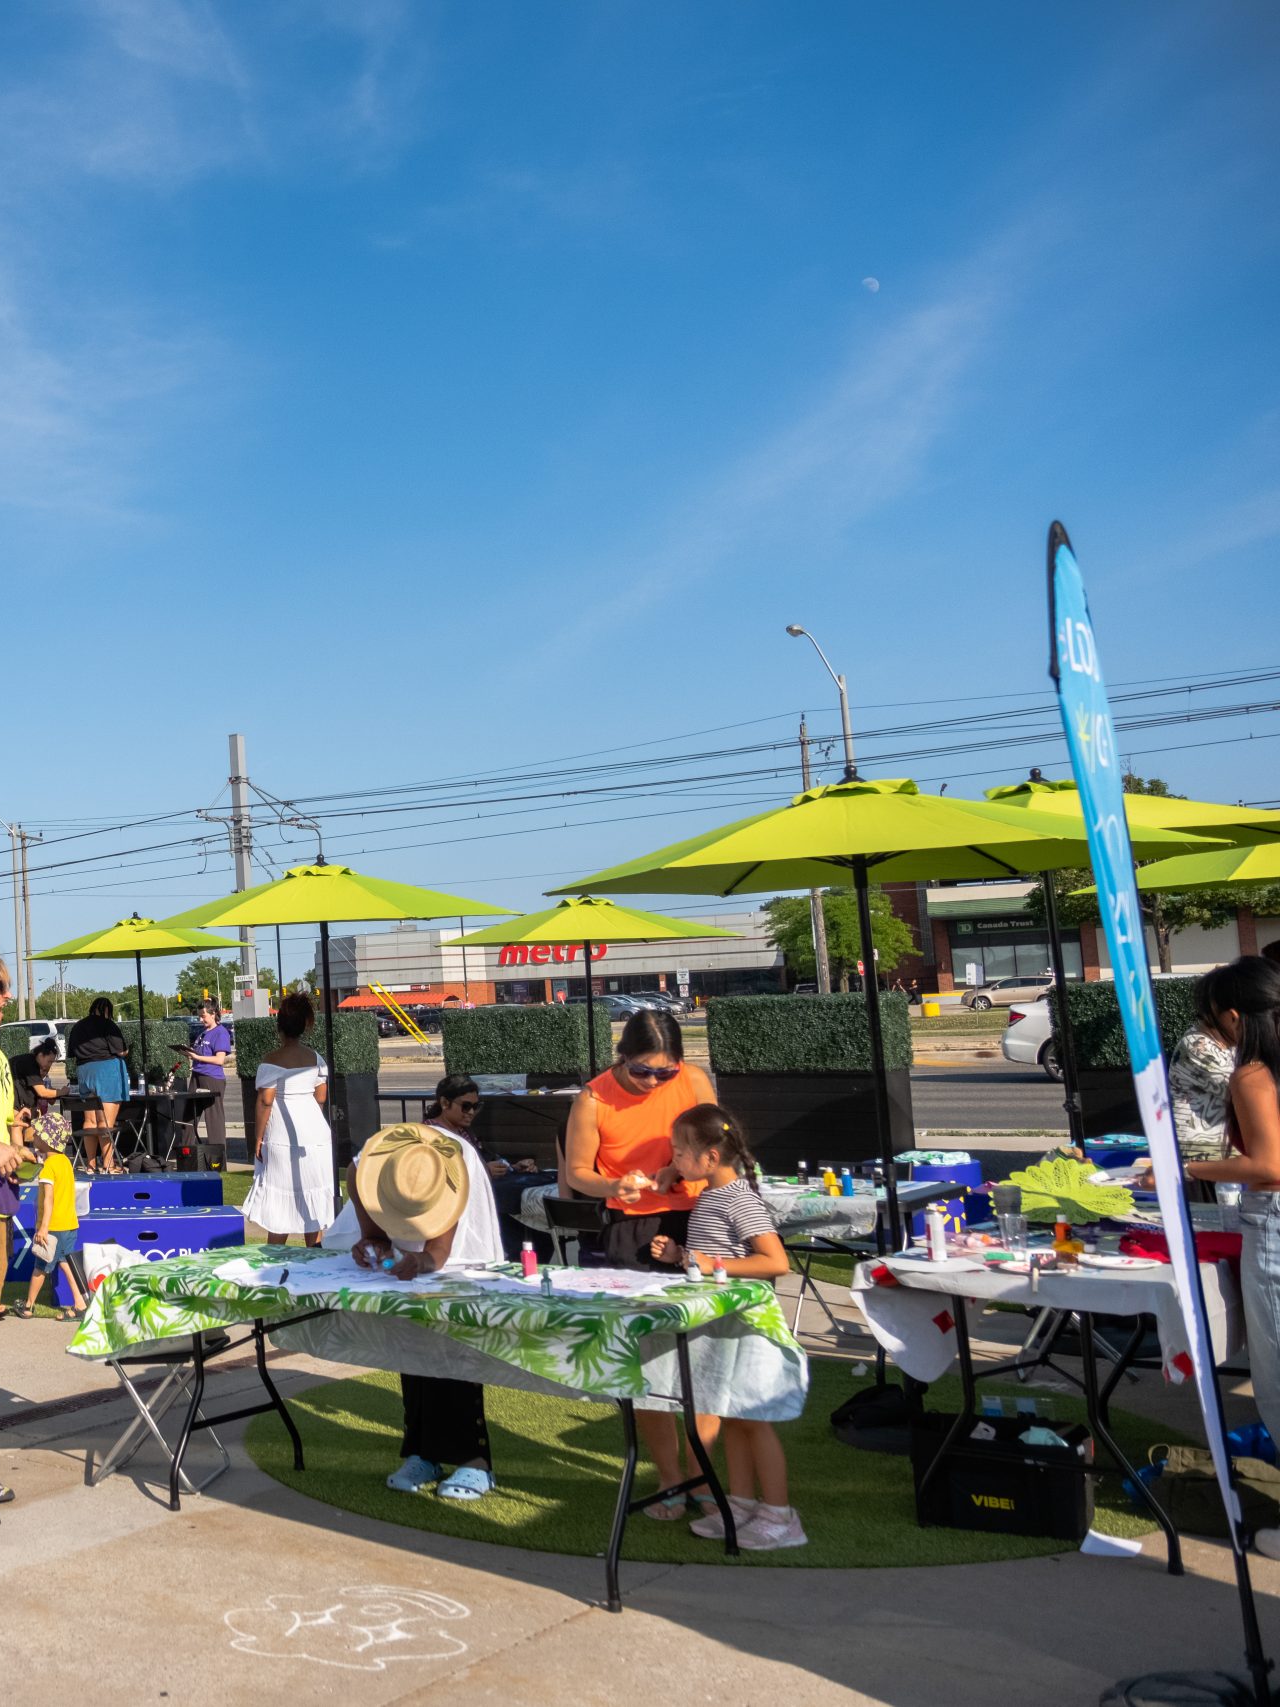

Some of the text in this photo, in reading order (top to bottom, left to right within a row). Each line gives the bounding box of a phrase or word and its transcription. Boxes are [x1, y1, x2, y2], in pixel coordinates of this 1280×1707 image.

[959, 920, 1034, 932] TD Canada Trust
[498, 943, 608, 967] metro
[970, 1493, 1011, 1510] VIBE
